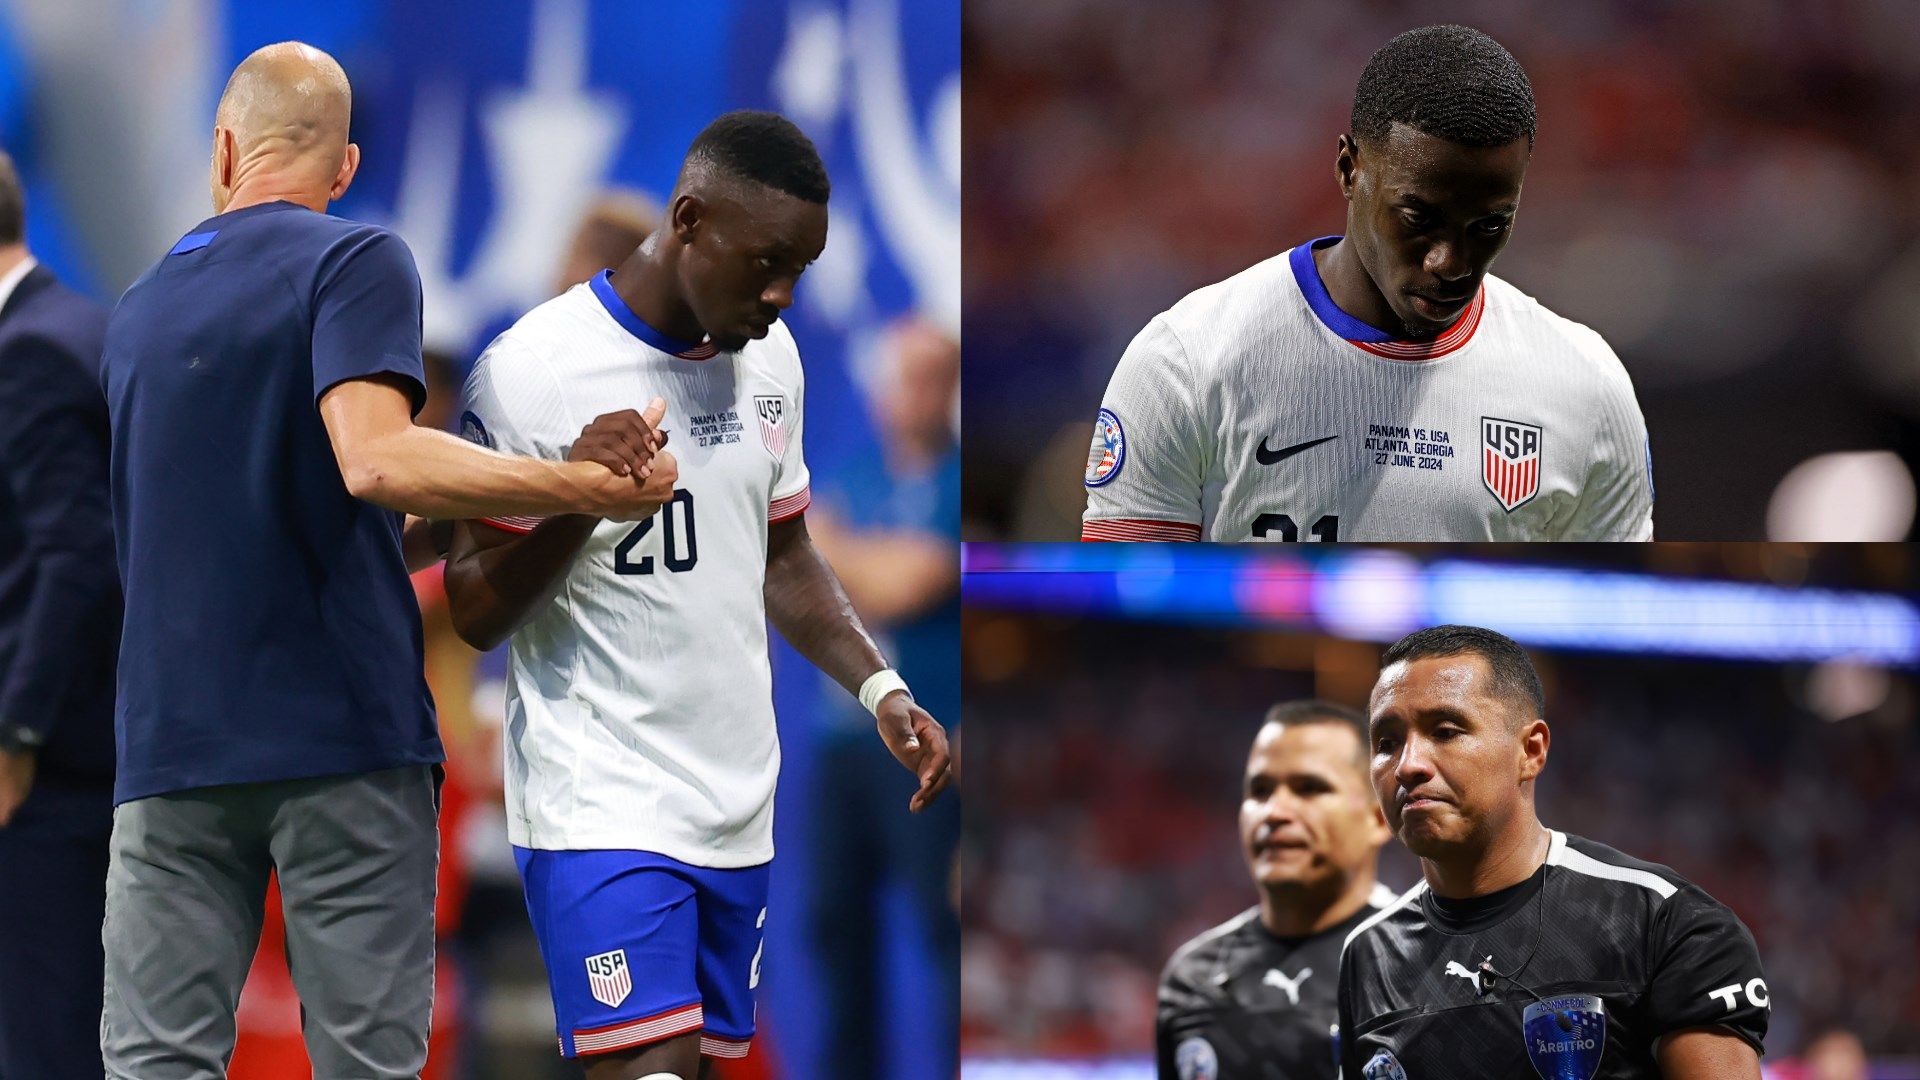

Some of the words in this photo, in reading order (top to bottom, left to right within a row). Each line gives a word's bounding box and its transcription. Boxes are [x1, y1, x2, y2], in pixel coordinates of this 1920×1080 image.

[690, 413, 717, 426] PANAMA
[727, 411, 739, 422] USA
[757, 399, 782, 425] USA
[720, 422, 744, 433] GEORGIA
[1369, 424, 1410, 439] PANAMA
[1414, 428, 1428, 441] VS.
[1430, 430, 1450, 443] USA
[709, 434, 724, 446] JUNE
[725, 433, 740, 443] 2024
[1365, 437, 1412, 454] ATLANTA,
[1414, 442, 1454, 458] GEORGIA
[1486, 423, 1537, 459] USA
[1375, 452, 1389, 465] 27
[1391, 454, 1416, 468] JUNE
[1418, 457, 1443, 470] 2024
[588, 952, 624, 976] USA
[1708, 977, 1771, 1012] TC
